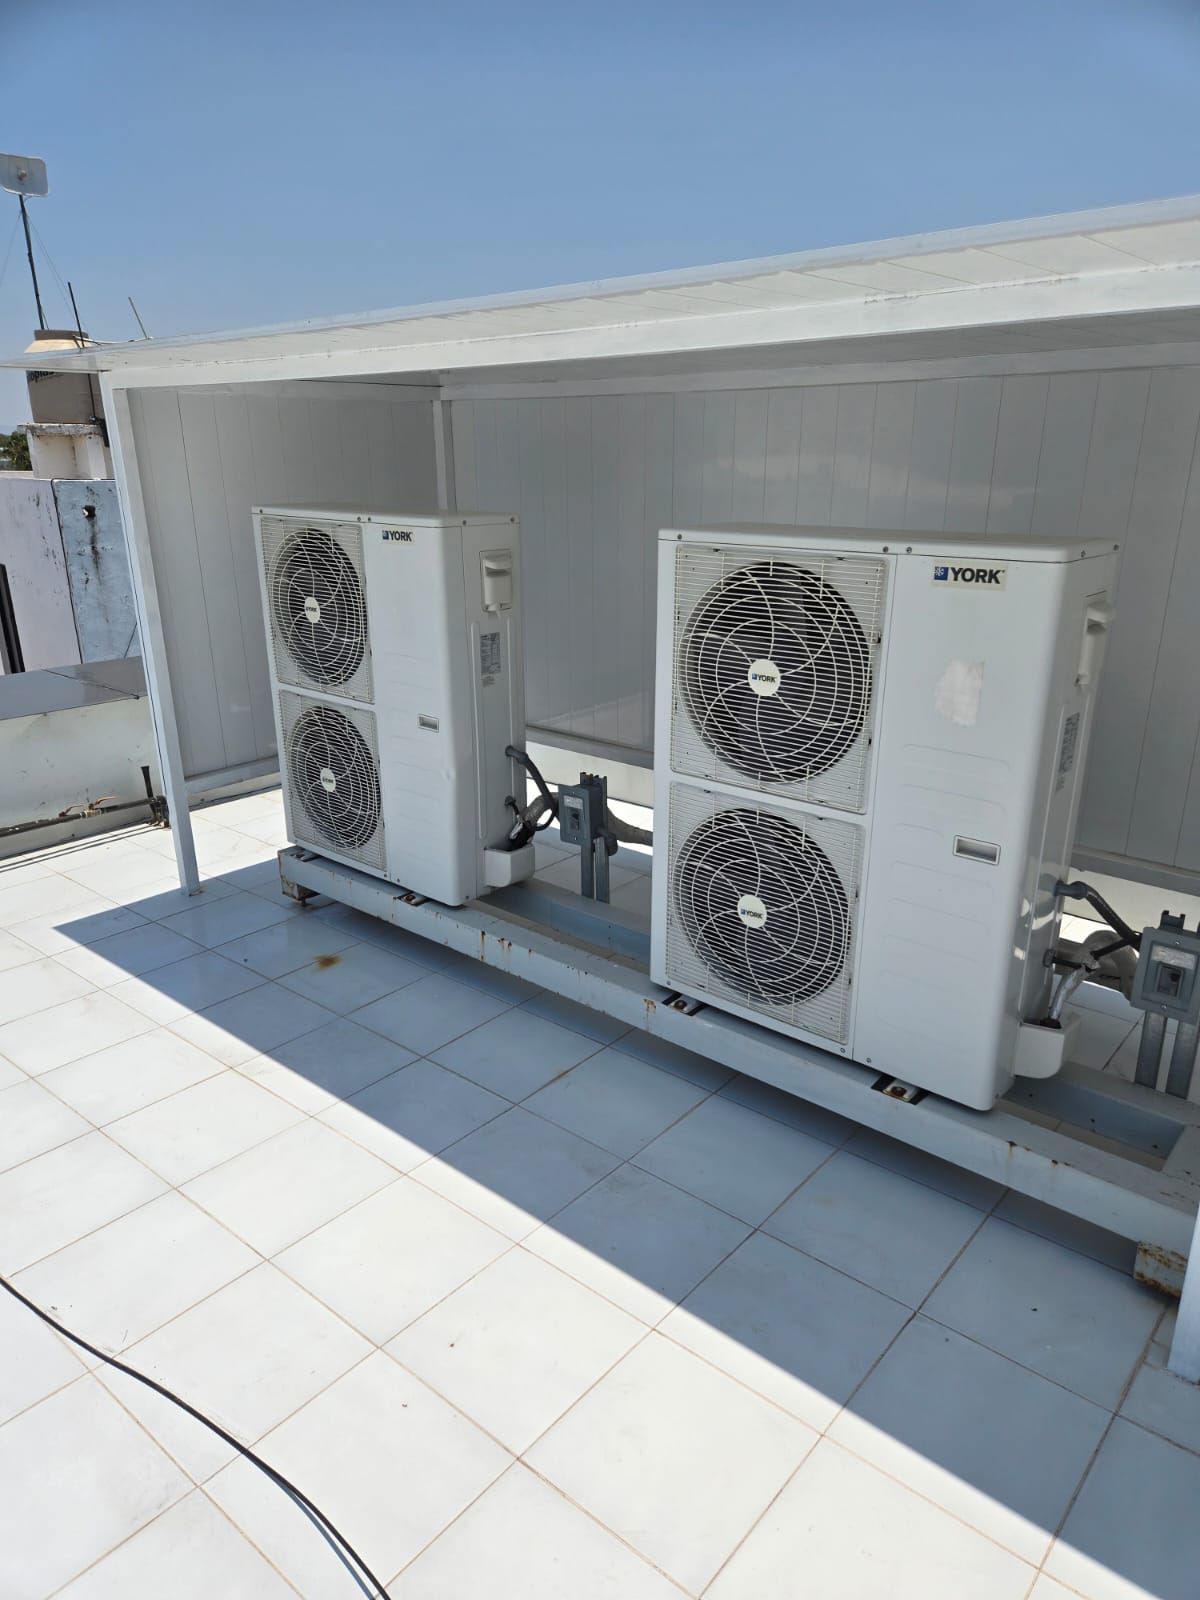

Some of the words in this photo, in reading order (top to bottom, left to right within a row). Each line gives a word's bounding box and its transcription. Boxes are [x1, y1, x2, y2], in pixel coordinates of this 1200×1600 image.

[389, 530, 412, 541] YORK
[951, 567, 1001, 584] YORK
[758, 674, 776, 683] YORK
[746, 910, 763, 919] YORK
